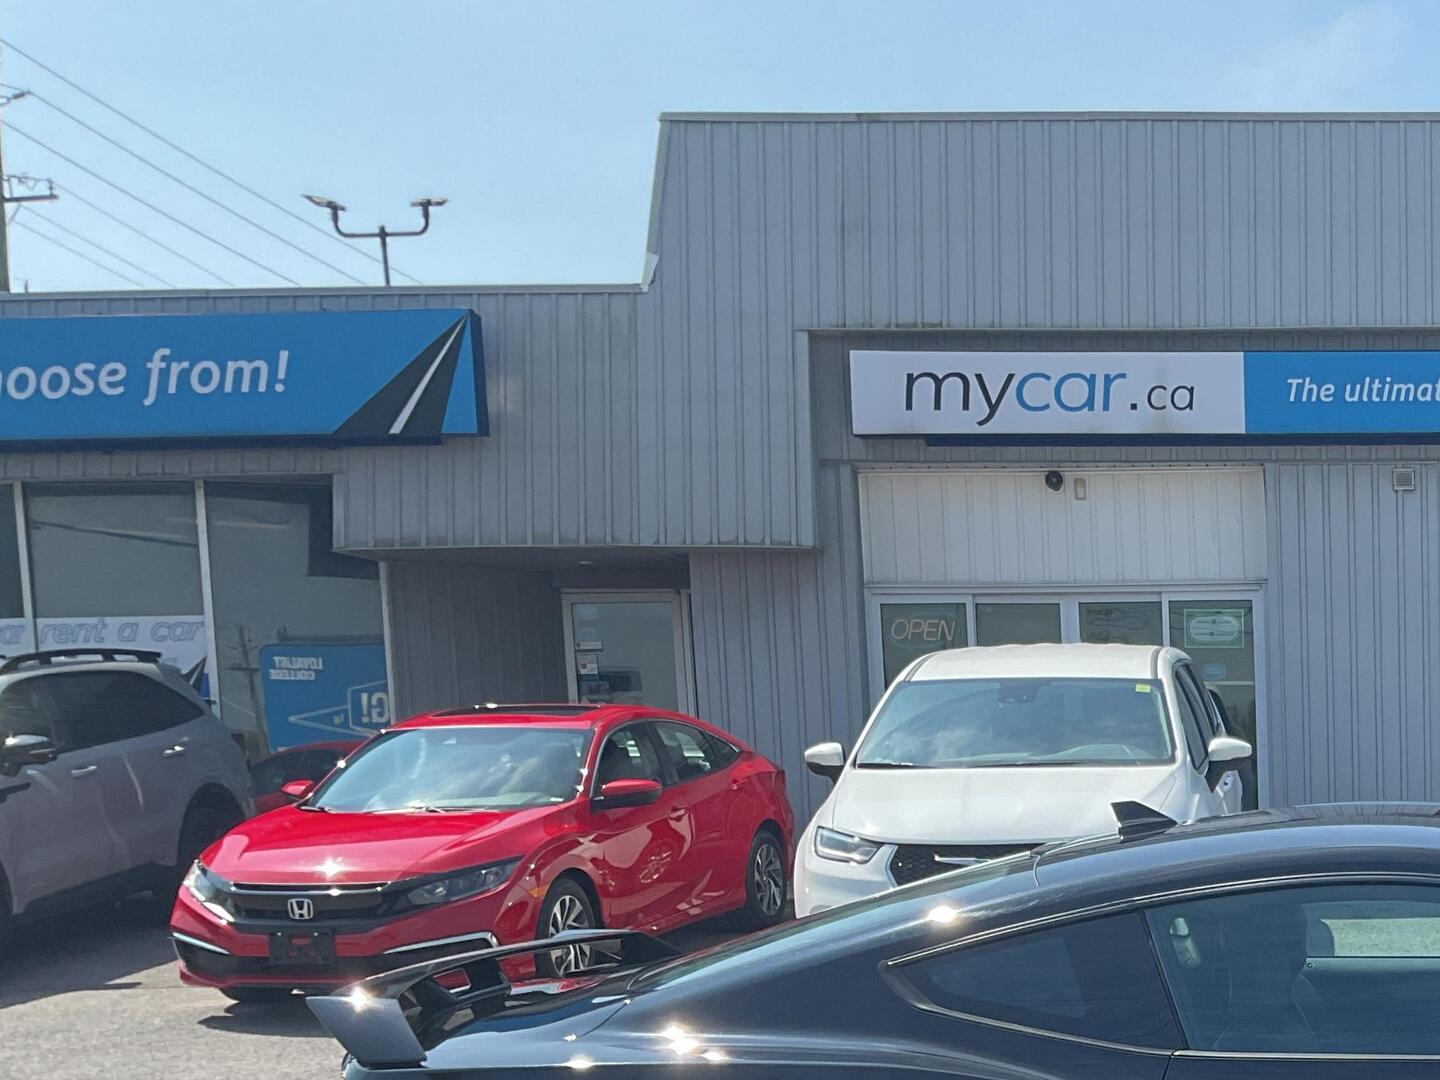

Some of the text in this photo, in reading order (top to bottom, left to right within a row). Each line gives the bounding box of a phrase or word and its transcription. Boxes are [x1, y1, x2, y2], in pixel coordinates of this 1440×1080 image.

[0, 348, 289, 406] oose from!
[905, 372, 1195, 426] mycar.ca
[1286, 378, 1334, 402] The
[40, 618, 107, 643] rent
[117, 622, 139, 643] a
[151, 621, 205, 642] car
[891, 619, 955, 641] OPEN
